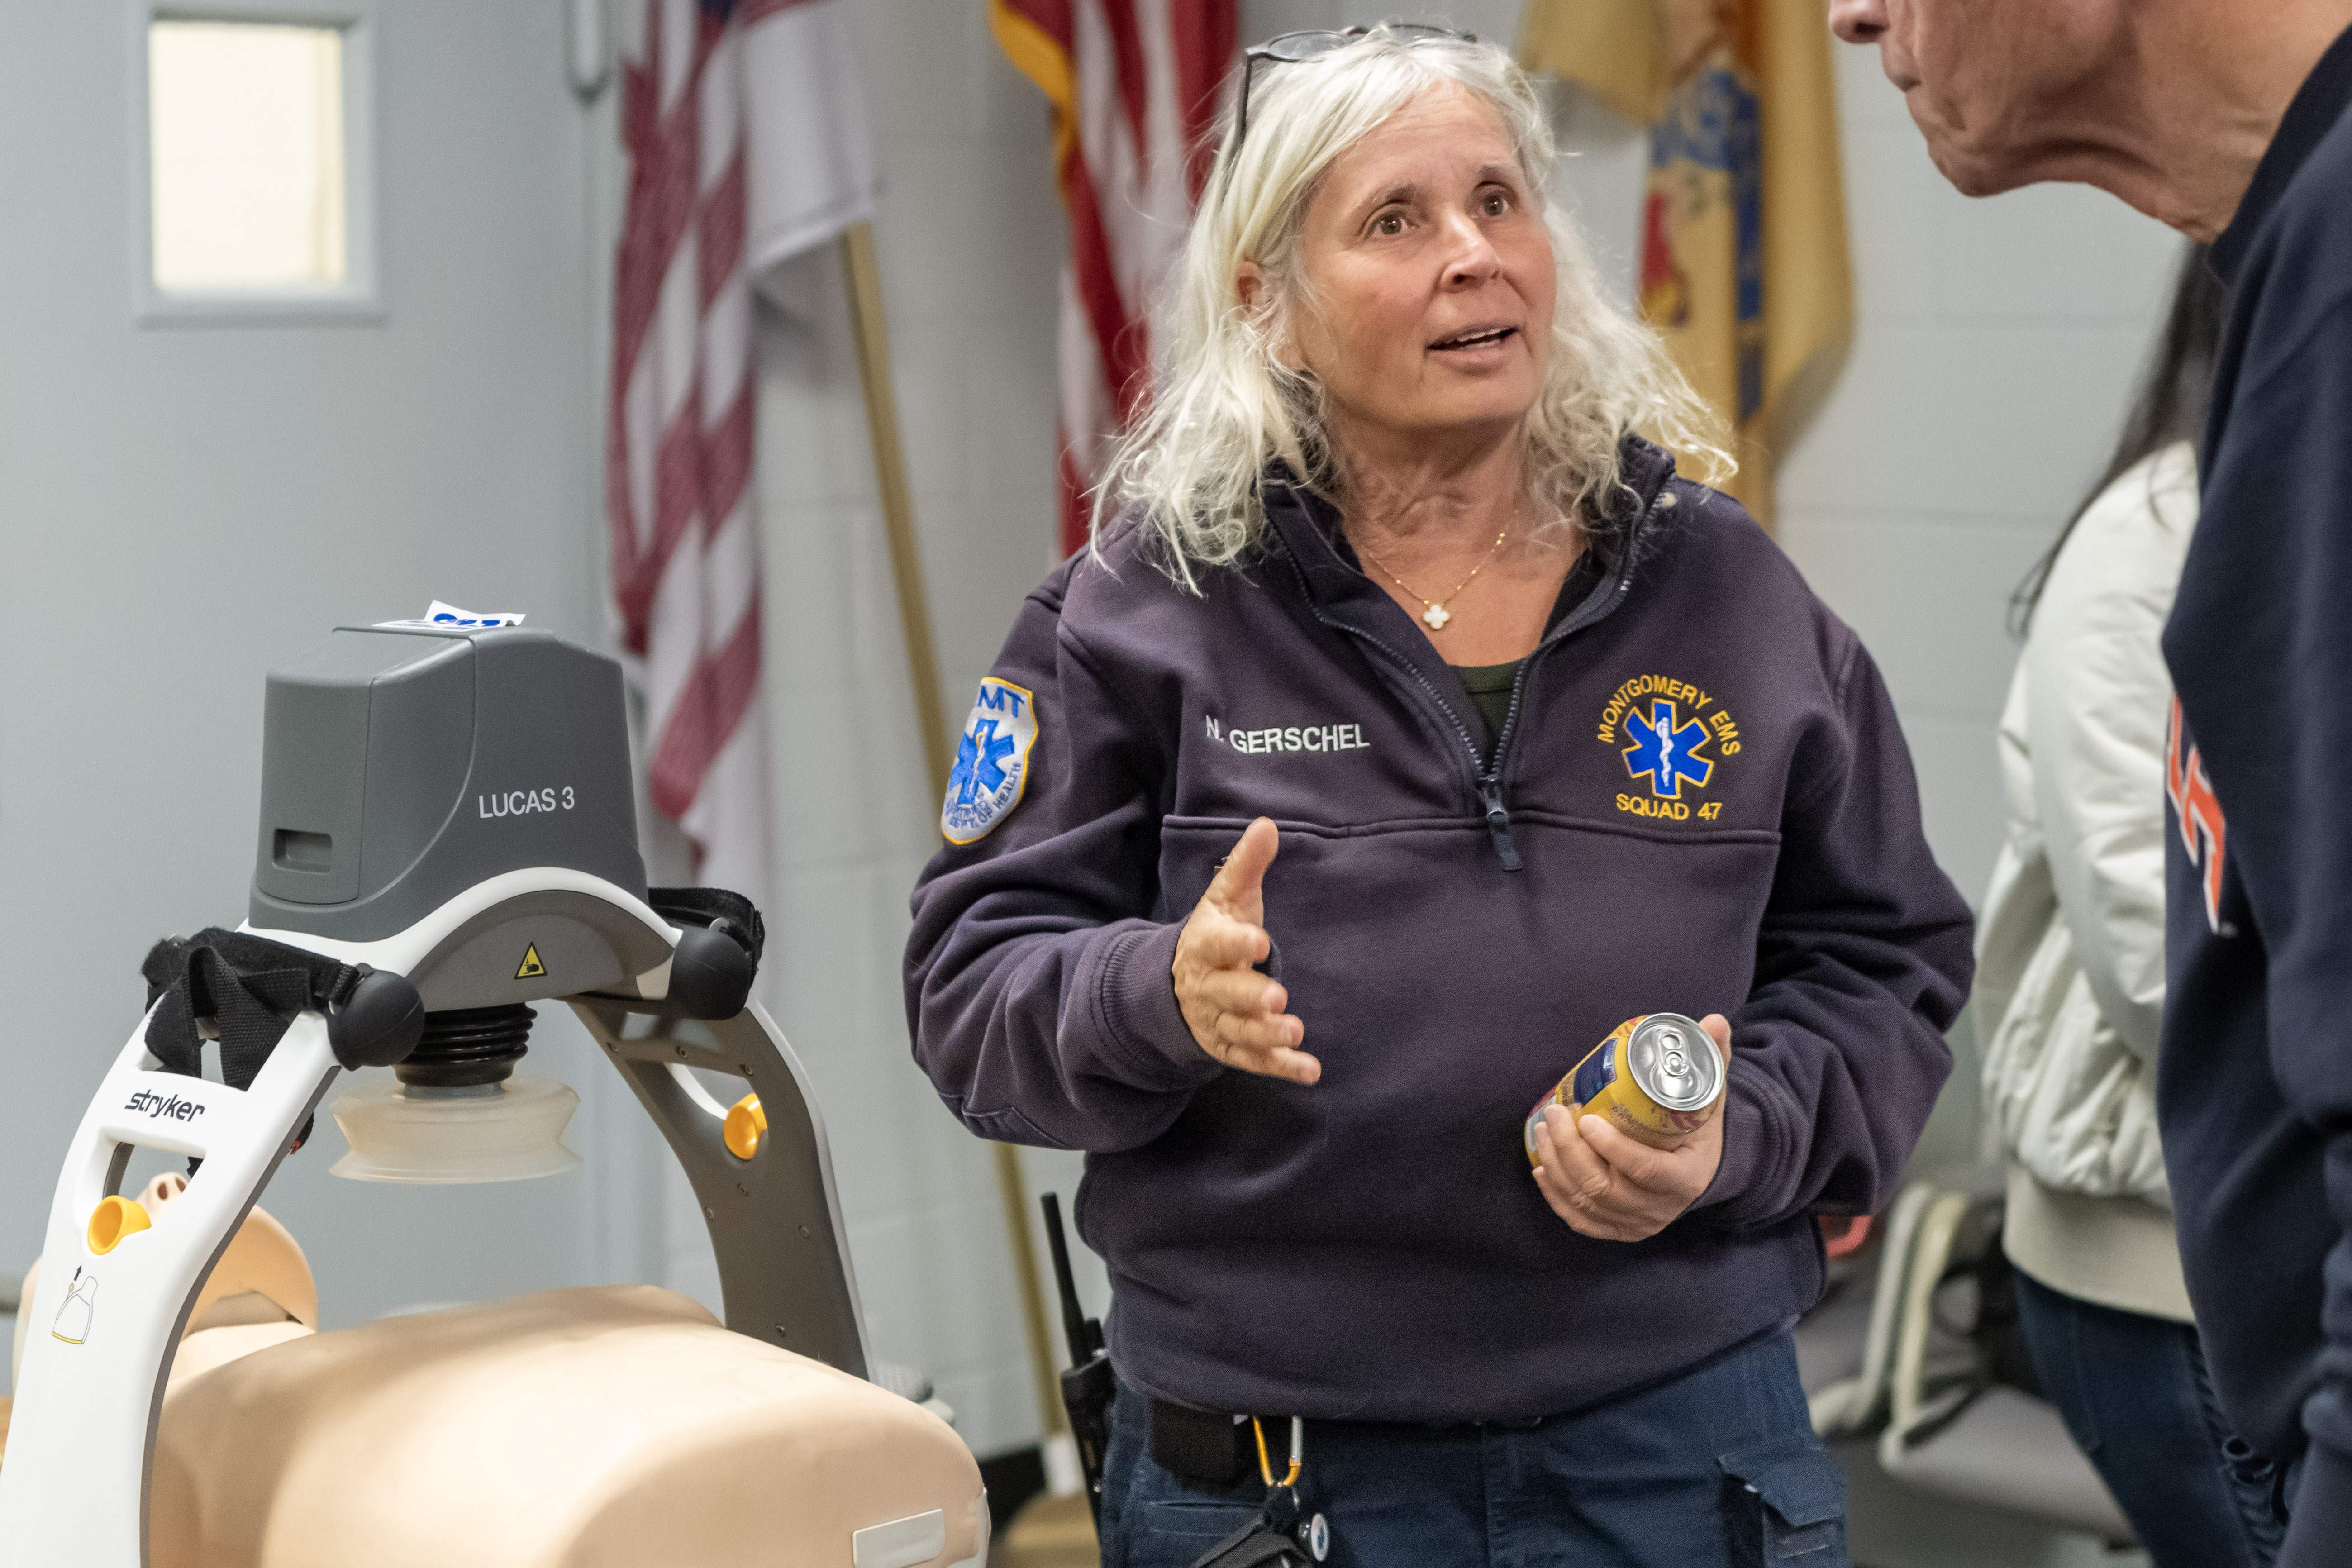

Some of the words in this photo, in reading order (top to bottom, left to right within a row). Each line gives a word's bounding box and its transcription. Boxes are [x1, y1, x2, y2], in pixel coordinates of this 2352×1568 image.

[976, 685, 1024, 719] MT
[1597, 675, 1713, 743] MONTGOMERY
[1709, 710, 1741, 756] EMS
[1205, 715, 1224, 742] N.
[1229, 724, 1371, 753] GERSCHEL
[479, 788, 556, 818] LUCAS
[562, 786, 575, 810] 3
[992, 762, 1021, 810] HEALTH
[1616, 793, 1690, 820] SQUAD
[1697, 802, 1723, 820] 47
[124, 1089, 205, 1122] stryker
